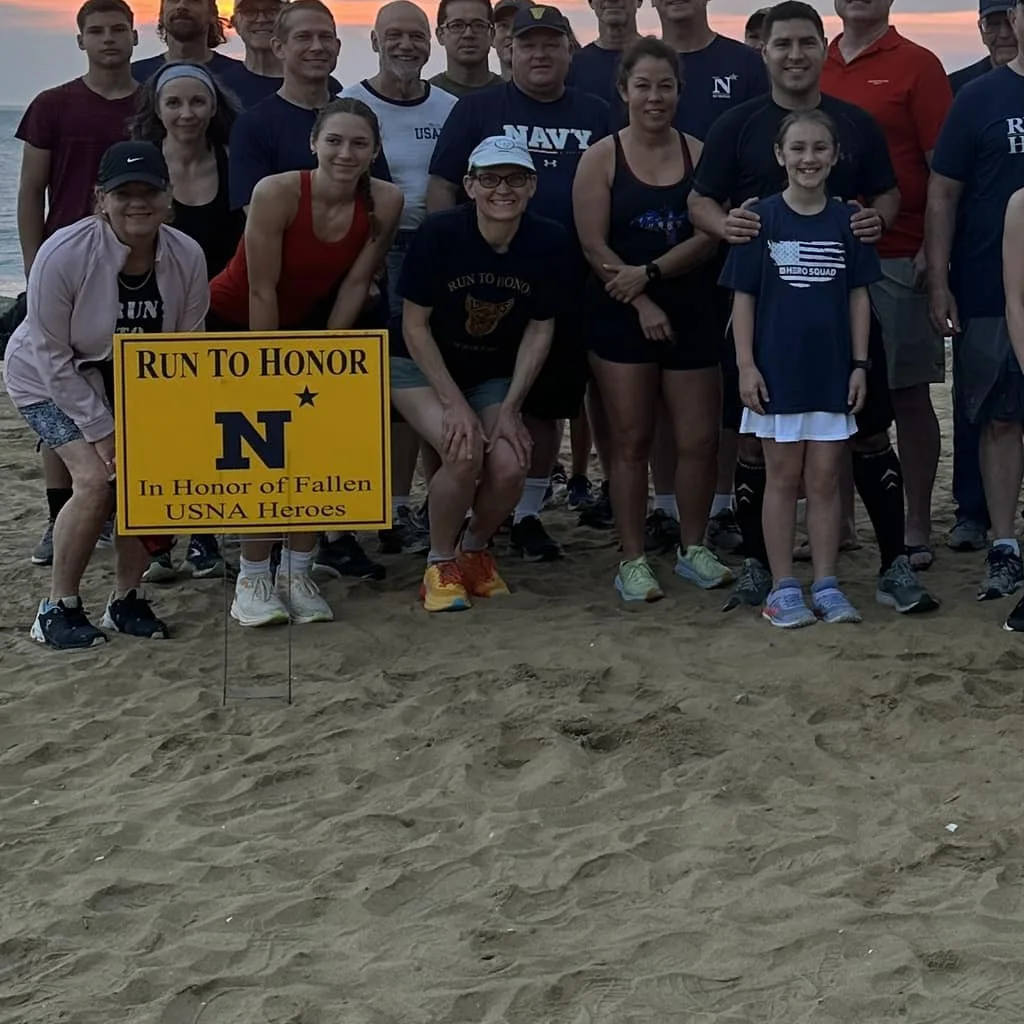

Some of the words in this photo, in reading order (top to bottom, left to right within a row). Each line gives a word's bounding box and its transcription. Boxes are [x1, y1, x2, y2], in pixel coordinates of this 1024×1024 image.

[503, 125, 592, 150] NAVY
[786, 266, 808, 275] HERO
[808, 267, 837, 276] SQUAD
[447, 273, 475, 292] RUN
[479, 272, 495, 285] TO
[496, 275, 532, 295] HONO
[214, 410, 292, 470] N
[139, 479, 163, 496] In
[173, 478, 252, 496] Honor
[259, 476, 289, 493] of
[293, 476, 372, 493] Fallen
[165, 502, 248, 521] USNA
[257, 501, 347, 519] Heroes
